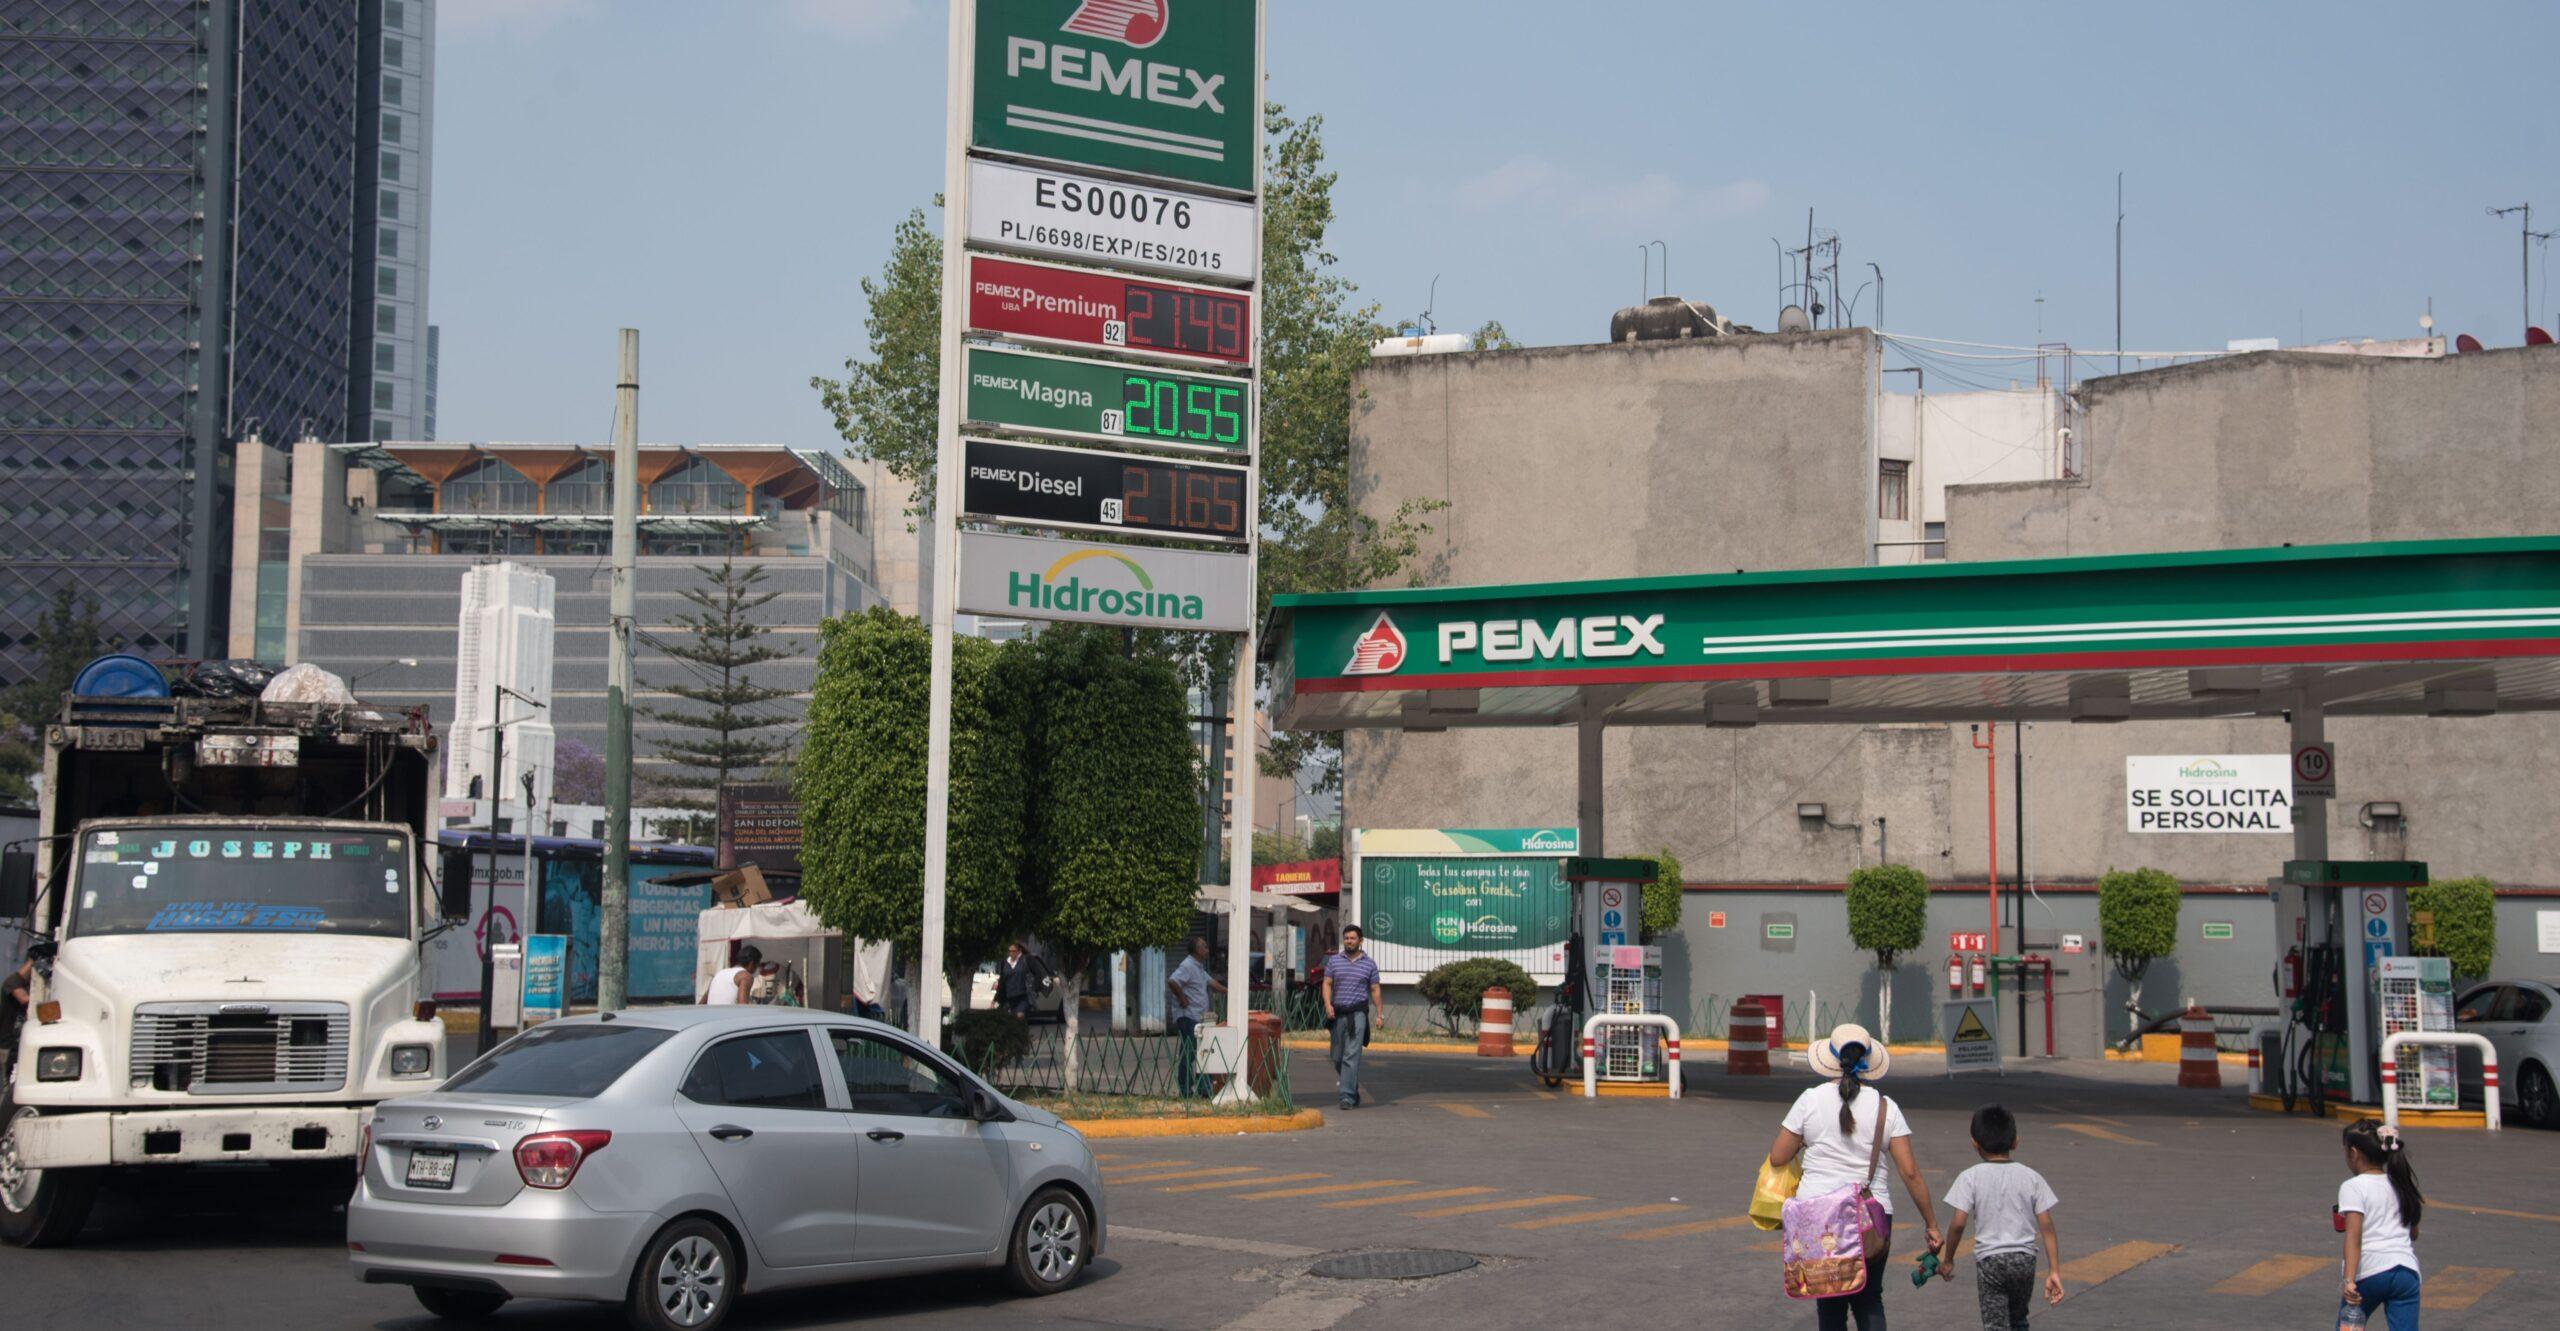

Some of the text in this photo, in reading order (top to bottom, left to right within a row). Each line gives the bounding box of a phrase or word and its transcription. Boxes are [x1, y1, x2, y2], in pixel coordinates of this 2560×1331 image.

[1007, 36, 1225, 114] PEMEX
[1036, 178, 1191, 229] ES00076
[1001, 221, 1222, 269] PL/6698/EXP/ES/2015
[976, 282, 1117, 319] PEMEX Premium
[1002, 302, 1020, 312] UBA
[1128, 288, 1240, 355] 21.49
[1105, 323, 1120, 342] 92
[974, 374, 1093, 408] PEMEX Magna
[1125, 377, 1239, 443] 20.55
[1103, 412, 1118, 431] 87
[971, 466, 1082, 497] PEMEX Diesel
[1123, 466, 1238, 532] 21.65
[1102, 502, 1117, 519] 45
[1008, 571, 1204, 620] Hidrosina
[1438, 614, 1665, 663] PEMEX
[2303, 754, 2323, 769] 10
[2179, 766, 2238, 778] Hidrosina
[2132, 789, 2288, 807] SE SOLICITA
[734, 819, 754, 828] SAN
[2141, 811, 2281, 829] PERSONAL
[151, 840, 332, 860] JOSEPH
[1522, 837, 1575, 850] Hidrosina
[1275, 872, 1312, 883] TAQUERIA
[1417, 864, 1530, 881] Todas tus compras te dan
[1432, 881, 1476, 897] Gasolina
[1465, 897, 1482, 907] con
[643, 918, 661, 932] UN
[1436, 917, 1458, 926] PUN
[1466, 920, 1518, 933] Hidrosina
[1436, 928, 1458, 937] TOS
